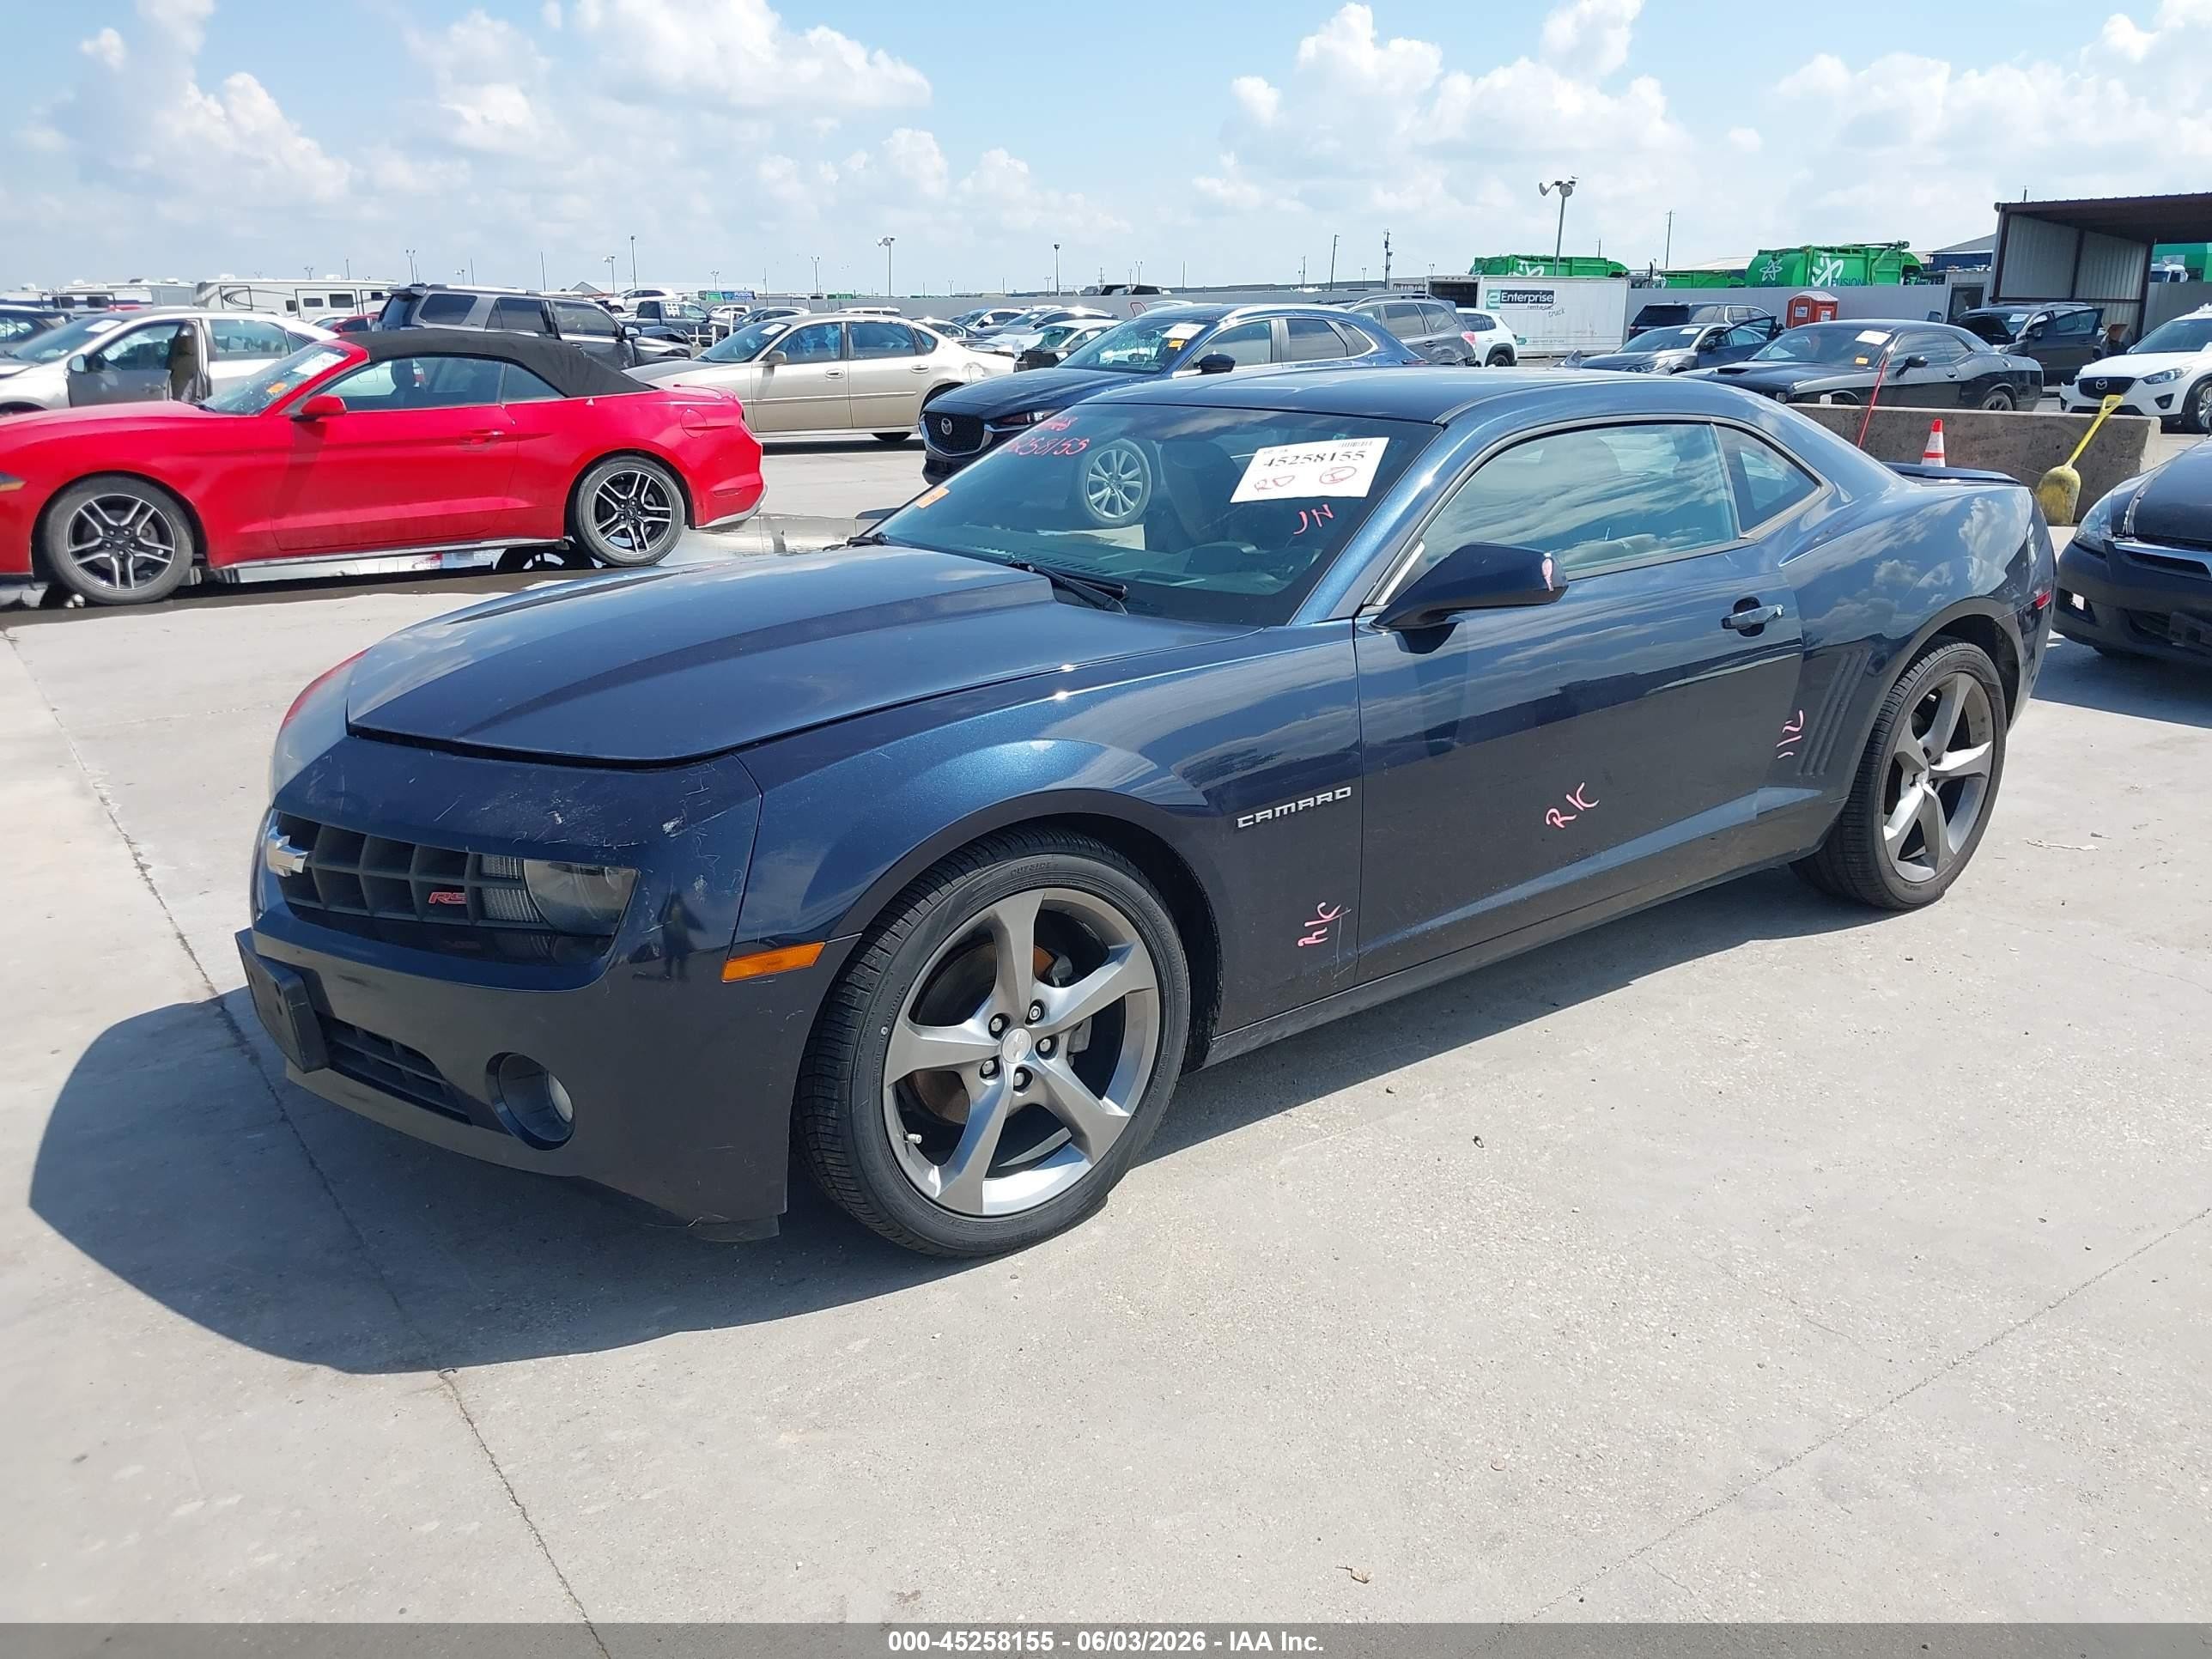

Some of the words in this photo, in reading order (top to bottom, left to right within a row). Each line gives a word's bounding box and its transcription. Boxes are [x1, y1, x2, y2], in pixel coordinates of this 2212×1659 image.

[1501, 292, 1553, 305] Enterprise
[1547, 307, 1565, 318] truck
[1263, 449, 1367, 468] 45258155
[1237, 787, 1352, 828] CAMARO
[428, 891, 468, 904] RS
